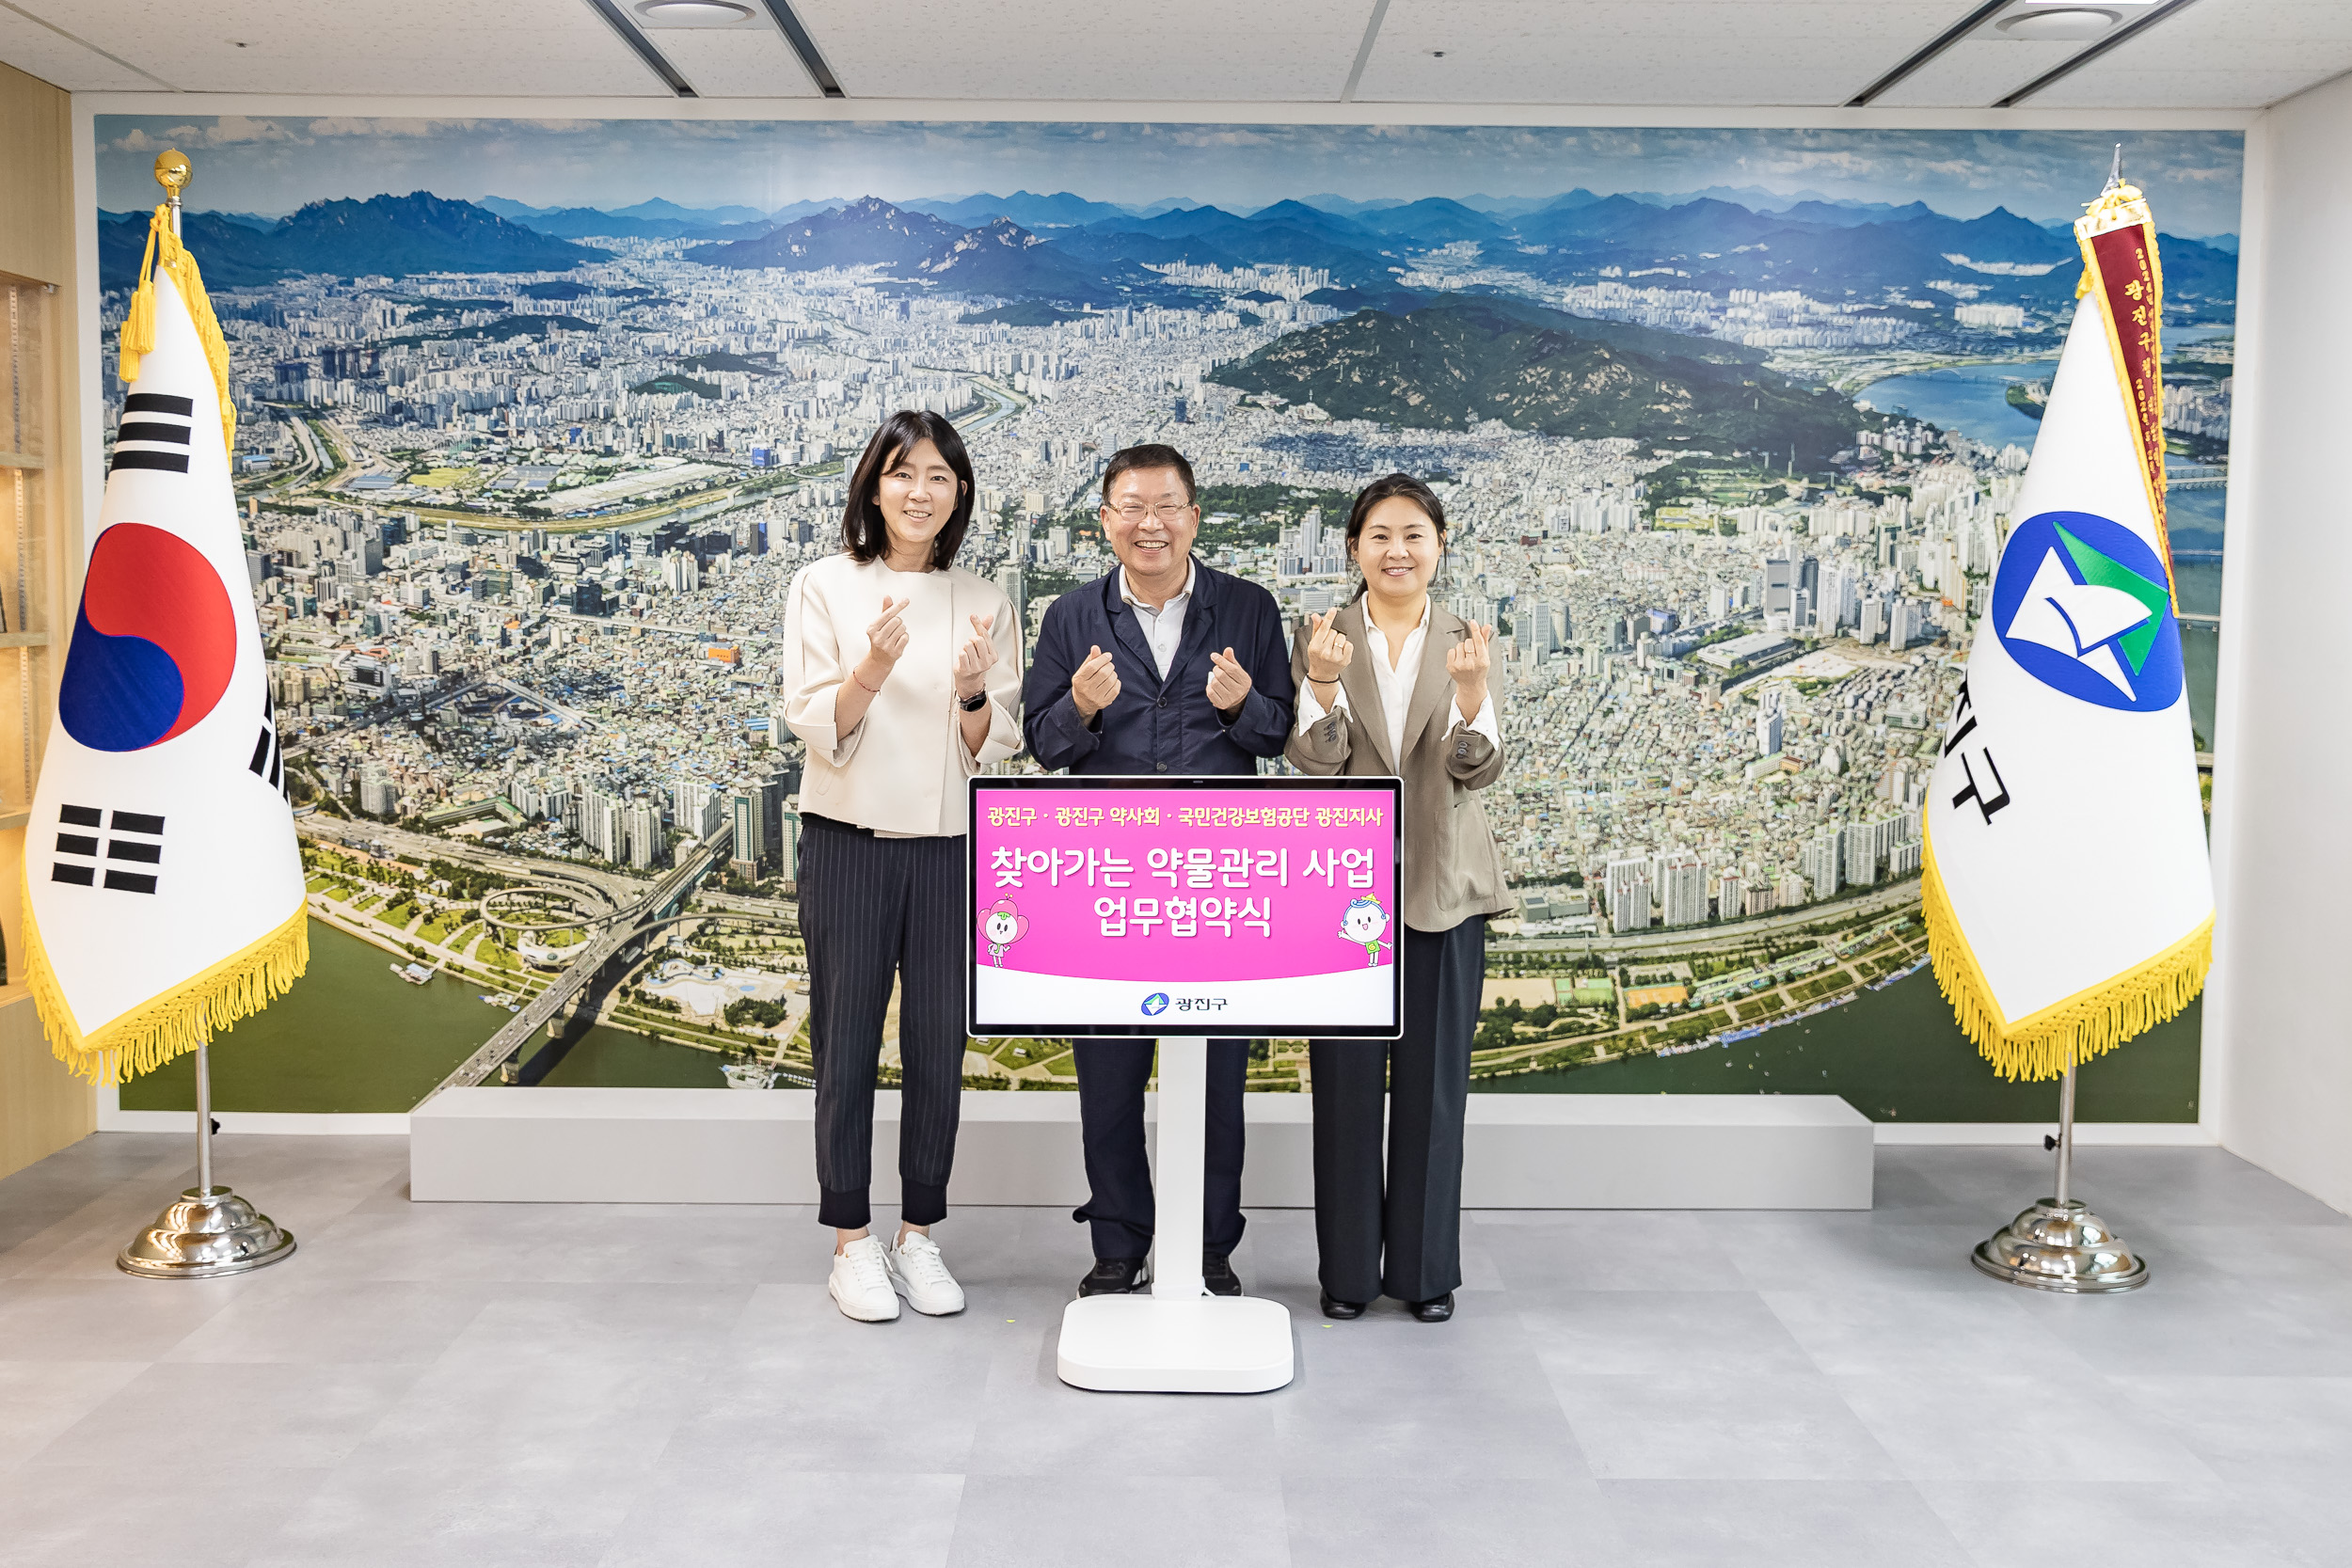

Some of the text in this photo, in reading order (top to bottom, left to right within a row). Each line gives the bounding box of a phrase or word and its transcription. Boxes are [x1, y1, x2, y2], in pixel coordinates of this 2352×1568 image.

[987, 806, 1038, 828] 광진구
[1054, 806, 1105, 828] 광진구
[1109, 806, 1161, 828] 약사회
[1177, 806, 1311, 828] 국민건강보험공단
[1314, 806, 1384, 828] 광진지사
[990, 847, 1375, 889] 찾아가는 약물관리 사업
[1093, 895, 1271, 938] 업무협약식
[1174, 997, 1229, 1012] 광진구
